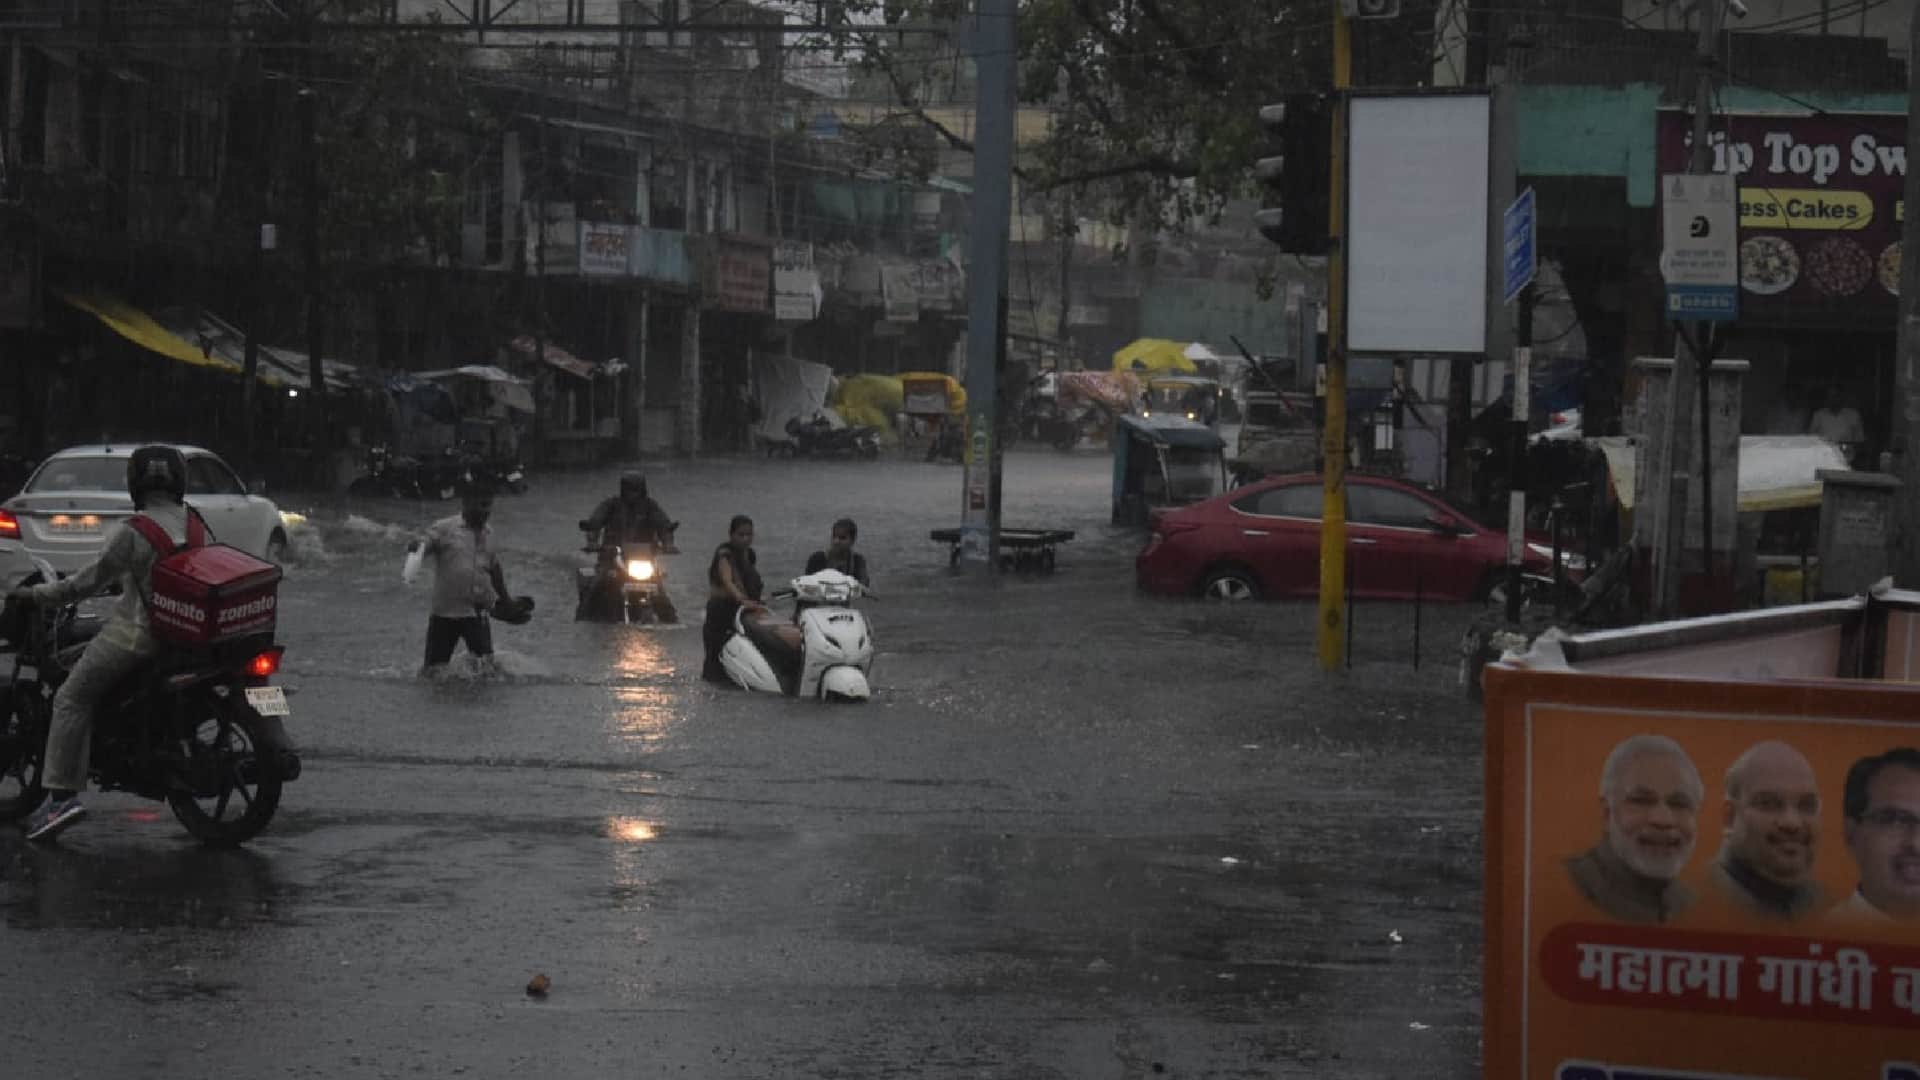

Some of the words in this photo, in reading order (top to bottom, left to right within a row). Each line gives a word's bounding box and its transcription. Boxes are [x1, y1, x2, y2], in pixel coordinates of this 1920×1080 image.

[1764, 132, 1840, 183] Top
[1786, 199, 1857, 220] Cakes
[152, 591, 205, 622] zomato
[217, 594, 275, 623] zomato
[1577, 942, 1744, 1000] महात्मा
[1756, 943, 1879, 1011] गांधी
